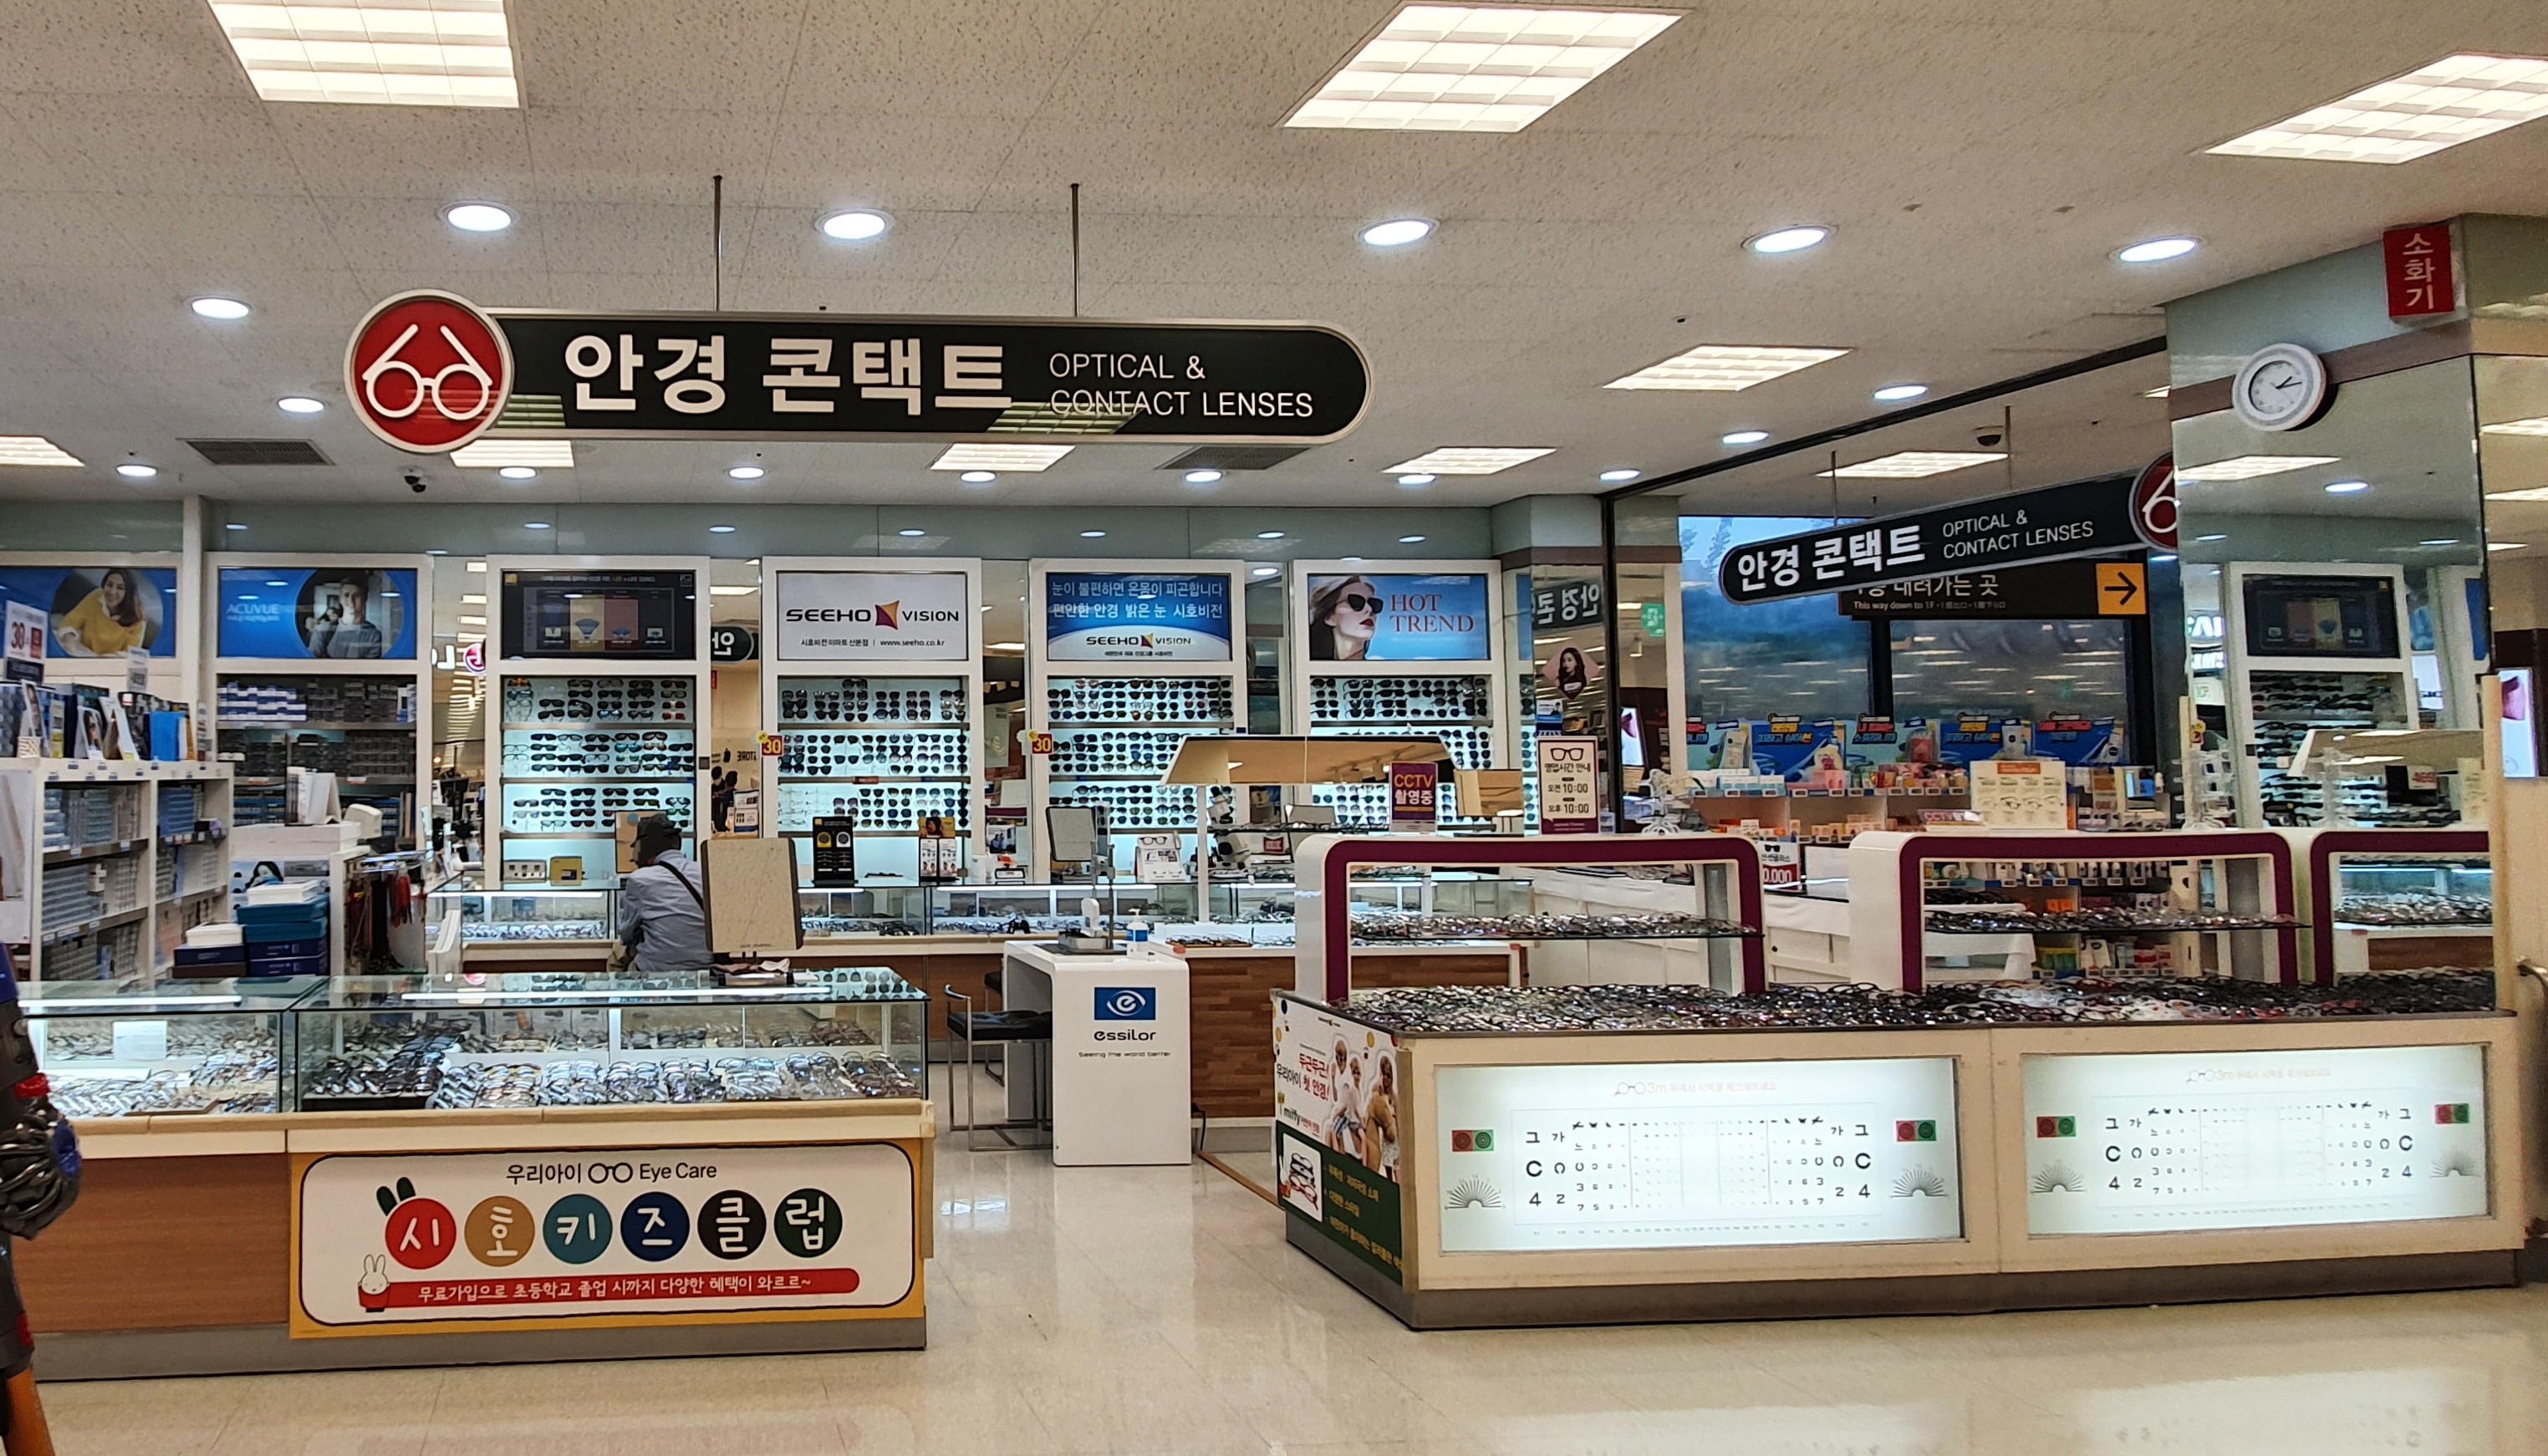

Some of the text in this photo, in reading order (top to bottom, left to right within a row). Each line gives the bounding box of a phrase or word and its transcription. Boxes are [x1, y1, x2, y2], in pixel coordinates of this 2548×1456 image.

[2402, 232, 2436, 311] 소화기
[1049, 353, 1206, 379] OPTICAL &
[565, 333, 1012, 416] 안경 콘택트
[1049, 389, 1314, 418] CONTACT LENSES
[1942, 508, 2028, 538] OPTICAL &
[1943, 520, 2095, 560] CONTACT LENSES
[1737, 524, 1926, 593] 안경 콘택트
[1052, 582, 1075, 597] 눈이
[1078, 582, 1124, 597] 불편하면
[1165, 582, 1223, 597] 피곤합니다
[1893, 574, 1974, 598] 내려가는
[1978, 573, 2000, 597] 곳
[226, 603, 280, 615] ACUVUE
[1052, 602, 1223, 619] 편안한 안경 밝은 눈 시호비전
[1390, 593, 1443, 612] HOT
[1852, 601, 1870, 609] This
[1872, 602, 1888, 612] way
[1890, 601, 1913, 610] down
[786, 608, 959, 623] SEEHO VISION
[1390, 613, 1475, 634] TREND
[879, 639, 945, 648] www.seeho.co.kr
[1086, 636, 1191, 645] SEEHO VISION
[762, 739, 782, 754] 30
[1033, 737, 1052, 752] 30
[1544, 762, 1591, 773] 영업시간 안내
[1394, 774, 1435, 788] CCTV
[1562, 783, 1589, 794] 10:00
[1395, 789, 1435, 807] 촬영중
[1548, 802, 1590, 814] 오후 10:00
[1093, 1029, 1156, 1041] essilor
[1299, 1052, 1330, 1080] 두근두근!
[1276, 1062, 1330, 1102] 우리아이 첫 안경!
[506, 1163, 583, 1185] 우리아이
[639, 1162, 717, 1183] Eye Care
[2402, 1164, 2413, 1178] 4
[2108, 1175, 2143, 1190] 4 2
[1528, 1192, 1566, 1207] 4 2
[1835, 1184, 1871, 1199] 2 4
[419, 1274, 812, 1303] 무료가입으로 초등학교 졸업 시까지 다양한 혜택이 와르르~
